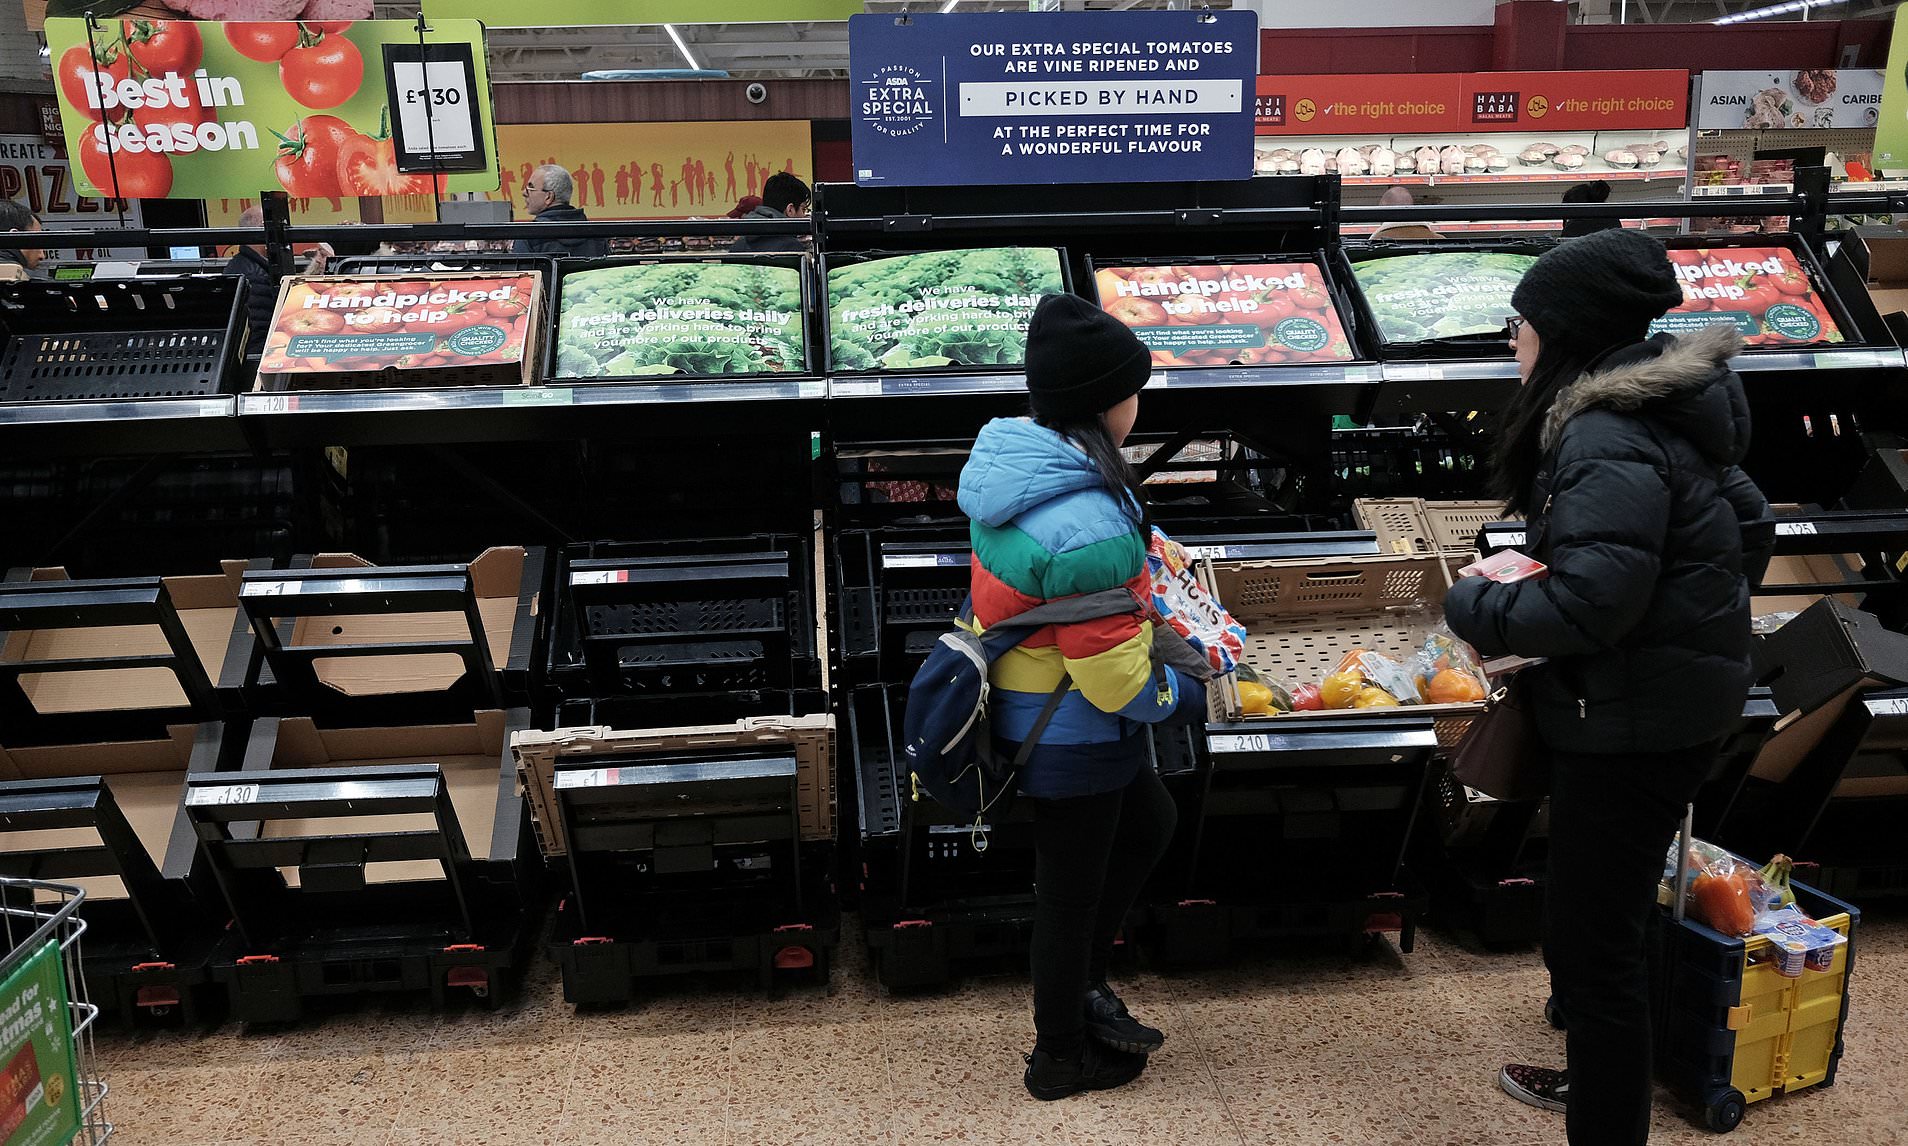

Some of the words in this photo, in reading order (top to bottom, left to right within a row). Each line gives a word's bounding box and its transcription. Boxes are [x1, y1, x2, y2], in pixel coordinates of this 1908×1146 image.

[970, 44, 1005, 56] OUR
[1012, 43, 1065, 56] EXTRA
[1071, 42, 1140, 55] SPECIAL
[1146, 41, 1233, 54] TOMATOES
[880, 65, 921, 78] PASSION
[1004, 61, 1037, 73] ARE
[1044, 60, 1083, 73] VINE
[1089, 59, 1159, 72] RIPENED
[1165, 59, 1199, 71] AND
[82, 71, 190, 109] Best
[195, 69, 245, 107] in
[885, 77, 908, 86] ASDA
[869, 87, 925, 100] EXTRA
[1005, 90, 1088, 106] PICKED
[1099, 90, 1126, 105] BY
[1136, 89, 1199, 104] HAND
[1477, 95, 1514, 103] HAJI
[1710, 95, 1747, 105] ASIAN
[862, 101, 933, 115] SPECIAL
[1334, 102, 1357, 116] the
[1361, 101, 1395, 119] right
[1397, 101, 1446, 115] choice
[1476, 104, 1514, 113] BABA
[1565, 98, 1588, 112] the
[1592, 98, 1625, 115] right
[1627, 97, 1674, 111] choice
[94, 120, 259, 153] season
[872, 122, 887, 134] FOR
[890, 121, 924, 137] QUALITY
[993, 127, 1013, 139] AT
[1019, 126, 1050, 138] THE
[1056, 125, 1129, 138] PERFECT
[1134, 124, 1172, 136] TIME
[1178, 124, 1210, 136] FOR
[0, 143, 46, 159] REATE
[1001, 143, 1013, 155] A
[1019, 141, 1122, 155] WONDERFUL
[1128, 140, 1202, 153] FLAVOUR
[0, 164, 129, 213] PIZ
[918, 287, 940, 297] We
[944, 285, 976, 294] have
[1114, 272, 1307, 298] Handpicked
[1684, 283, 1745, 300] help
[302, 285, 512, 310] Handpicked
[652, 297, 675, 306] We
[678, 297, 711, 305] have
[1375, 288, 1429, 303] fresh
[841, 304, 895, 323] fresh
[898, 294, 1000, 314] deliveries
[1161, 301, 1192, 315] to
[1198, 297, 1258, 314] help
[343, 311, 375, 325] to
[383, 308, 448, 324] help
[571, 311, 626, 328] fresh
[629, 308, 734, 323] deliveries
[738, 308, 792, 325] daily
[851, 322, 877, 333] and
[879, 319, 900, 329] are
[904, 312, 959, 325] working
[962, 310, 992, 320] hard
[995, 310, 1011, 319] to
[579, 326, 605, 338] and
[607, 326, 631, 335] are
[634, 323, 690, 334] working
[693, 323, 725, 332] hard
[726, 324, 744, 333] to
[746, 324, 782, 336] bring
[866, 332, 893, 343] you
[894, 327, 930, 339] more
[934, 325, 948, 333] of
[950, 325, 975, 333] our
[592, 338, 618, 350] you
[620, 335, 658, 346] more
[662, 335, 677, 344] of
[680, 335, 704, 344] our
[707, 335, 769, 346] products
[22, 983, 39, 1005] for
